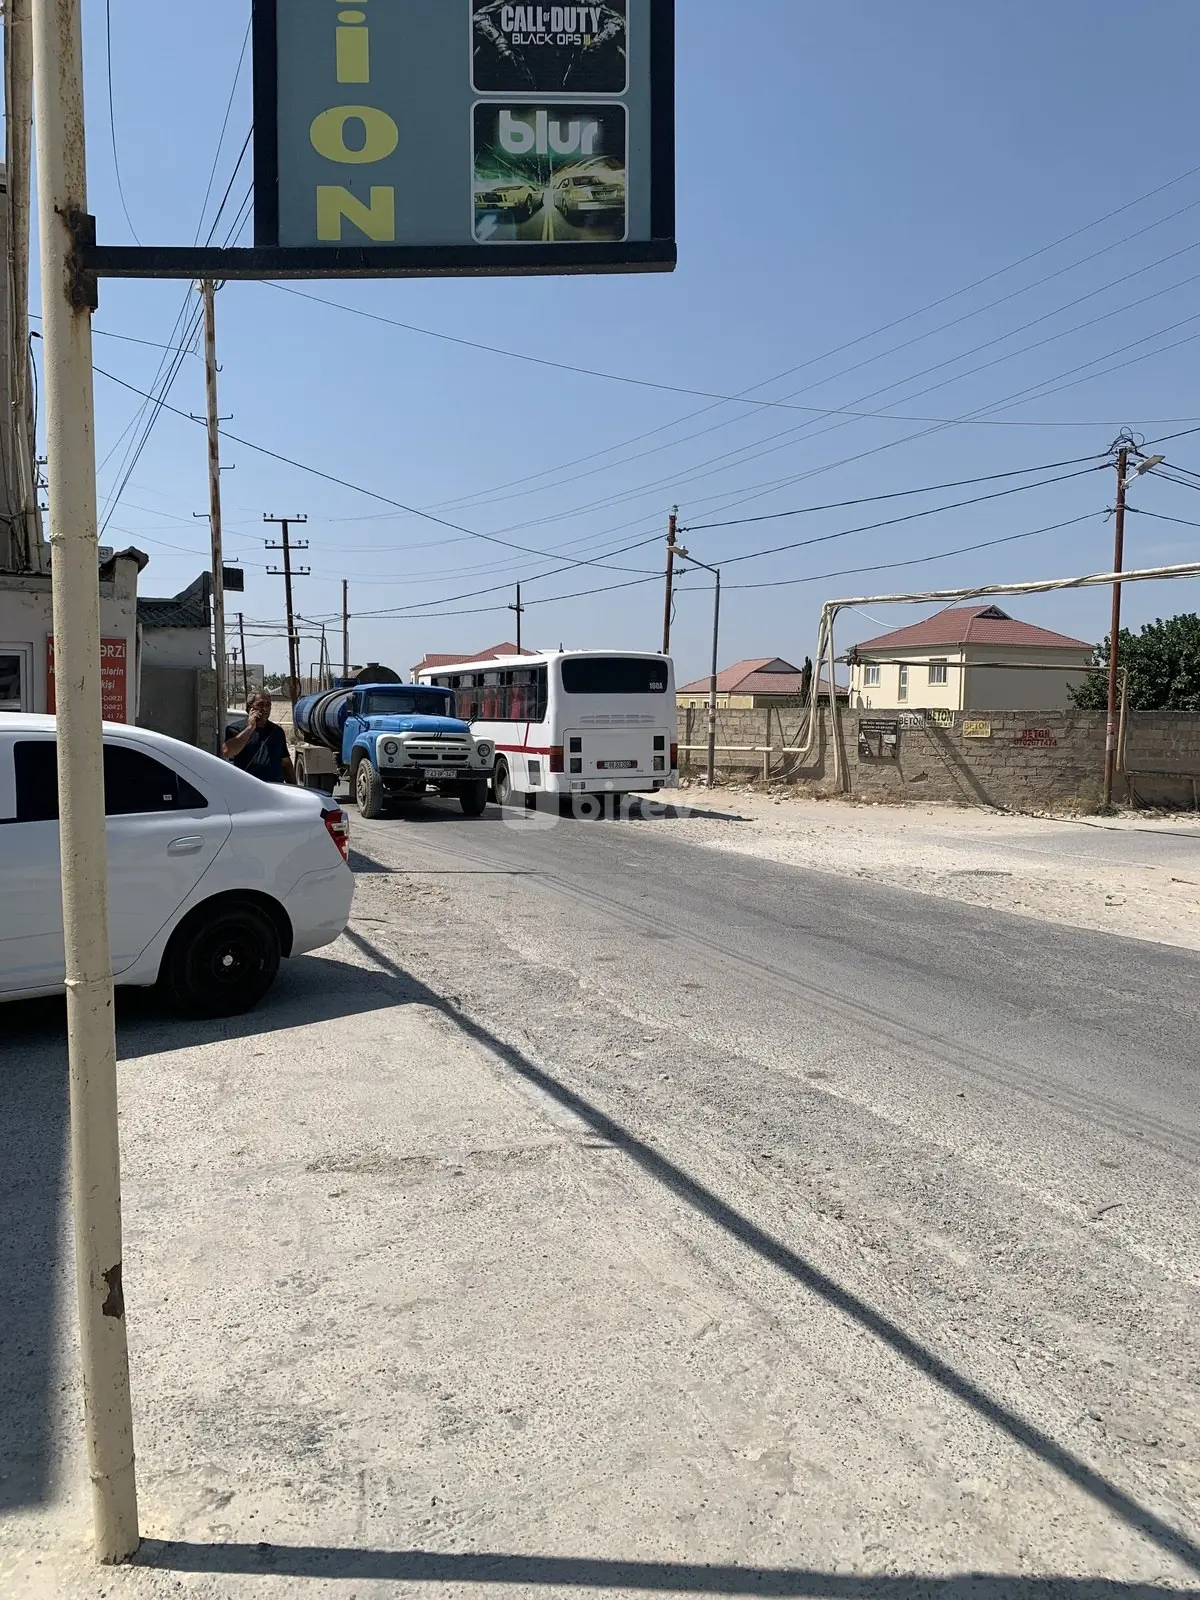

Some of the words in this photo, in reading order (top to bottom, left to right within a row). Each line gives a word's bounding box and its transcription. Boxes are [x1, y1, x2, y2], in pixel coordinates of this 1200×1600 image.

[500, 5, 545, 32] CALL
[551, 6, 602, 33] DUTY
[512, 33, 554, 45] BLACK
[557, 33, 582, 45] OPS
[499, 110, 598, 154] blur
[100, 643, 126, 658] ƏRZİ
[101, 680, 115, 690] kişi
[898, 716, 924, 726] BETON
[927, 710, 953, 722] BETON
